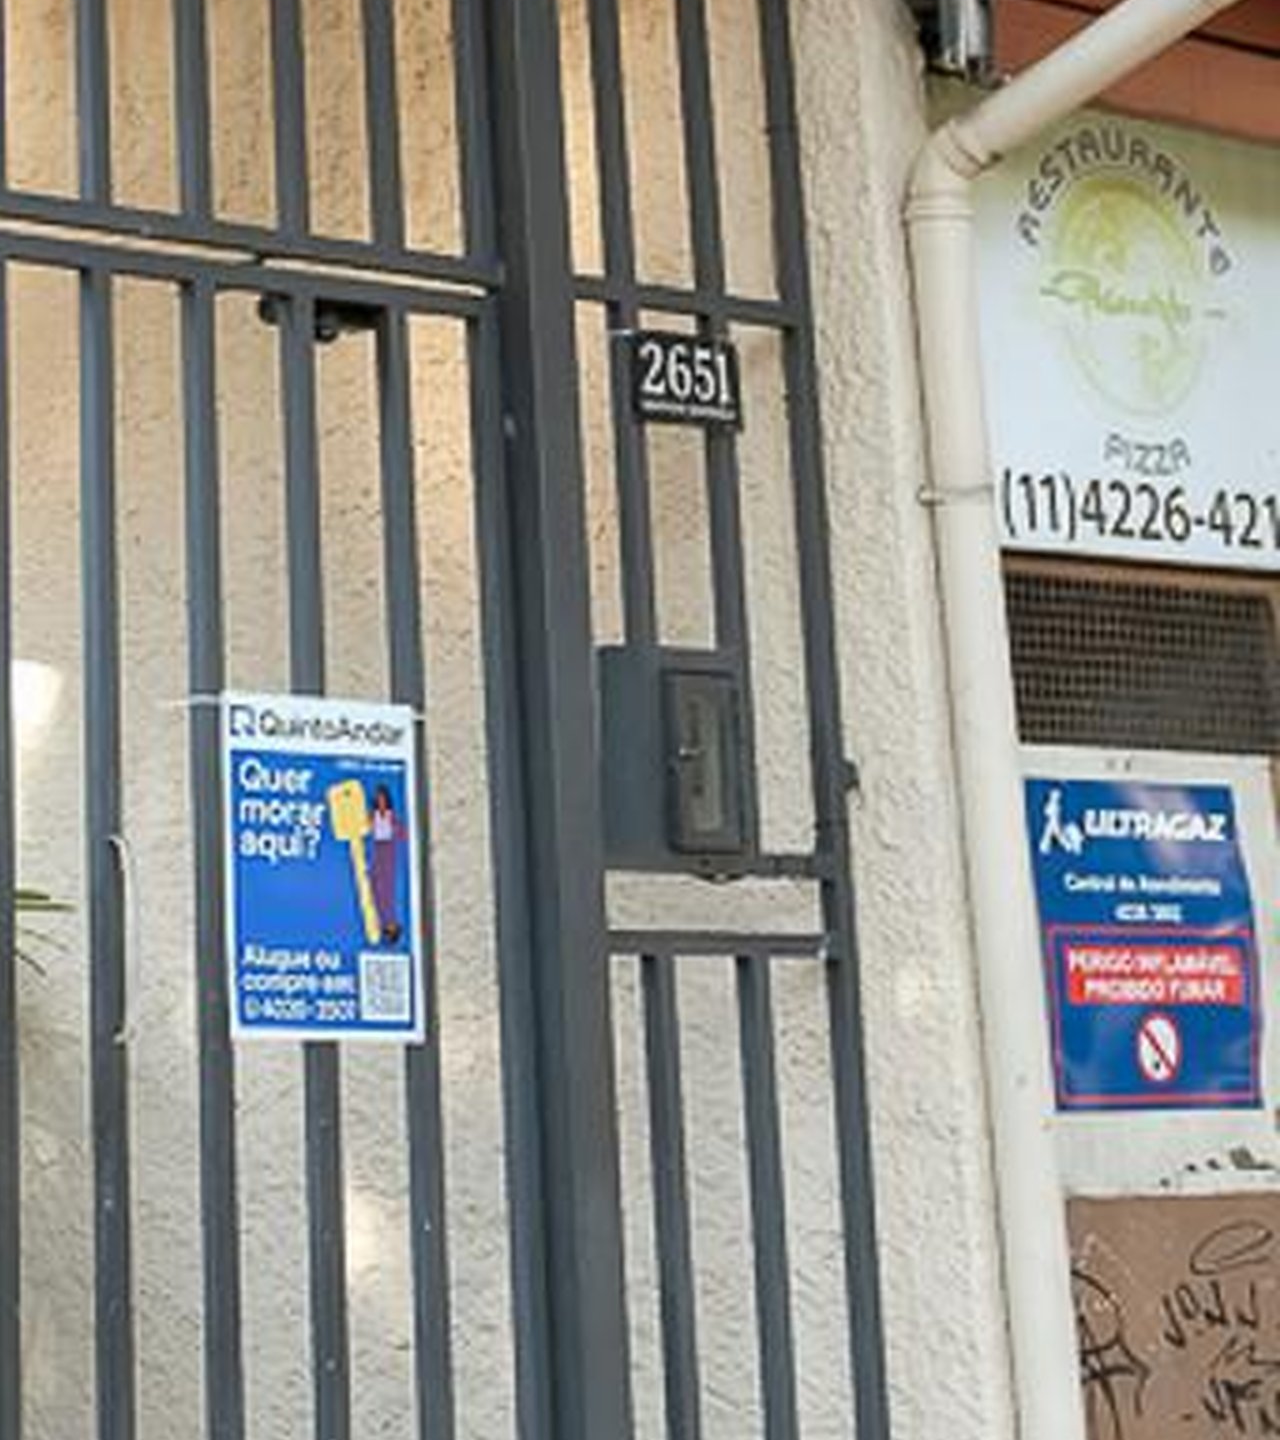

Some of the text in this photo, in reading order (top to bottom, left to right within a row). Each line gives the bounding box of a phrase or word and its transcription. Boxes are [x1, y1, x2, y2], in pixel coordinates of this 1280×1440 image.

[639, 341, 730, 404] 2651
[1104, 433, 1191, 476] PIZZA
[260, 710, 404, 745] QuintoAndar
[240, 756, 314, 793] Quer
[240, 798, 325, 827] morar
[1083, 808, 1226, 841] ULTRAGAZ
[240, 829, 321, 864] aqui?
